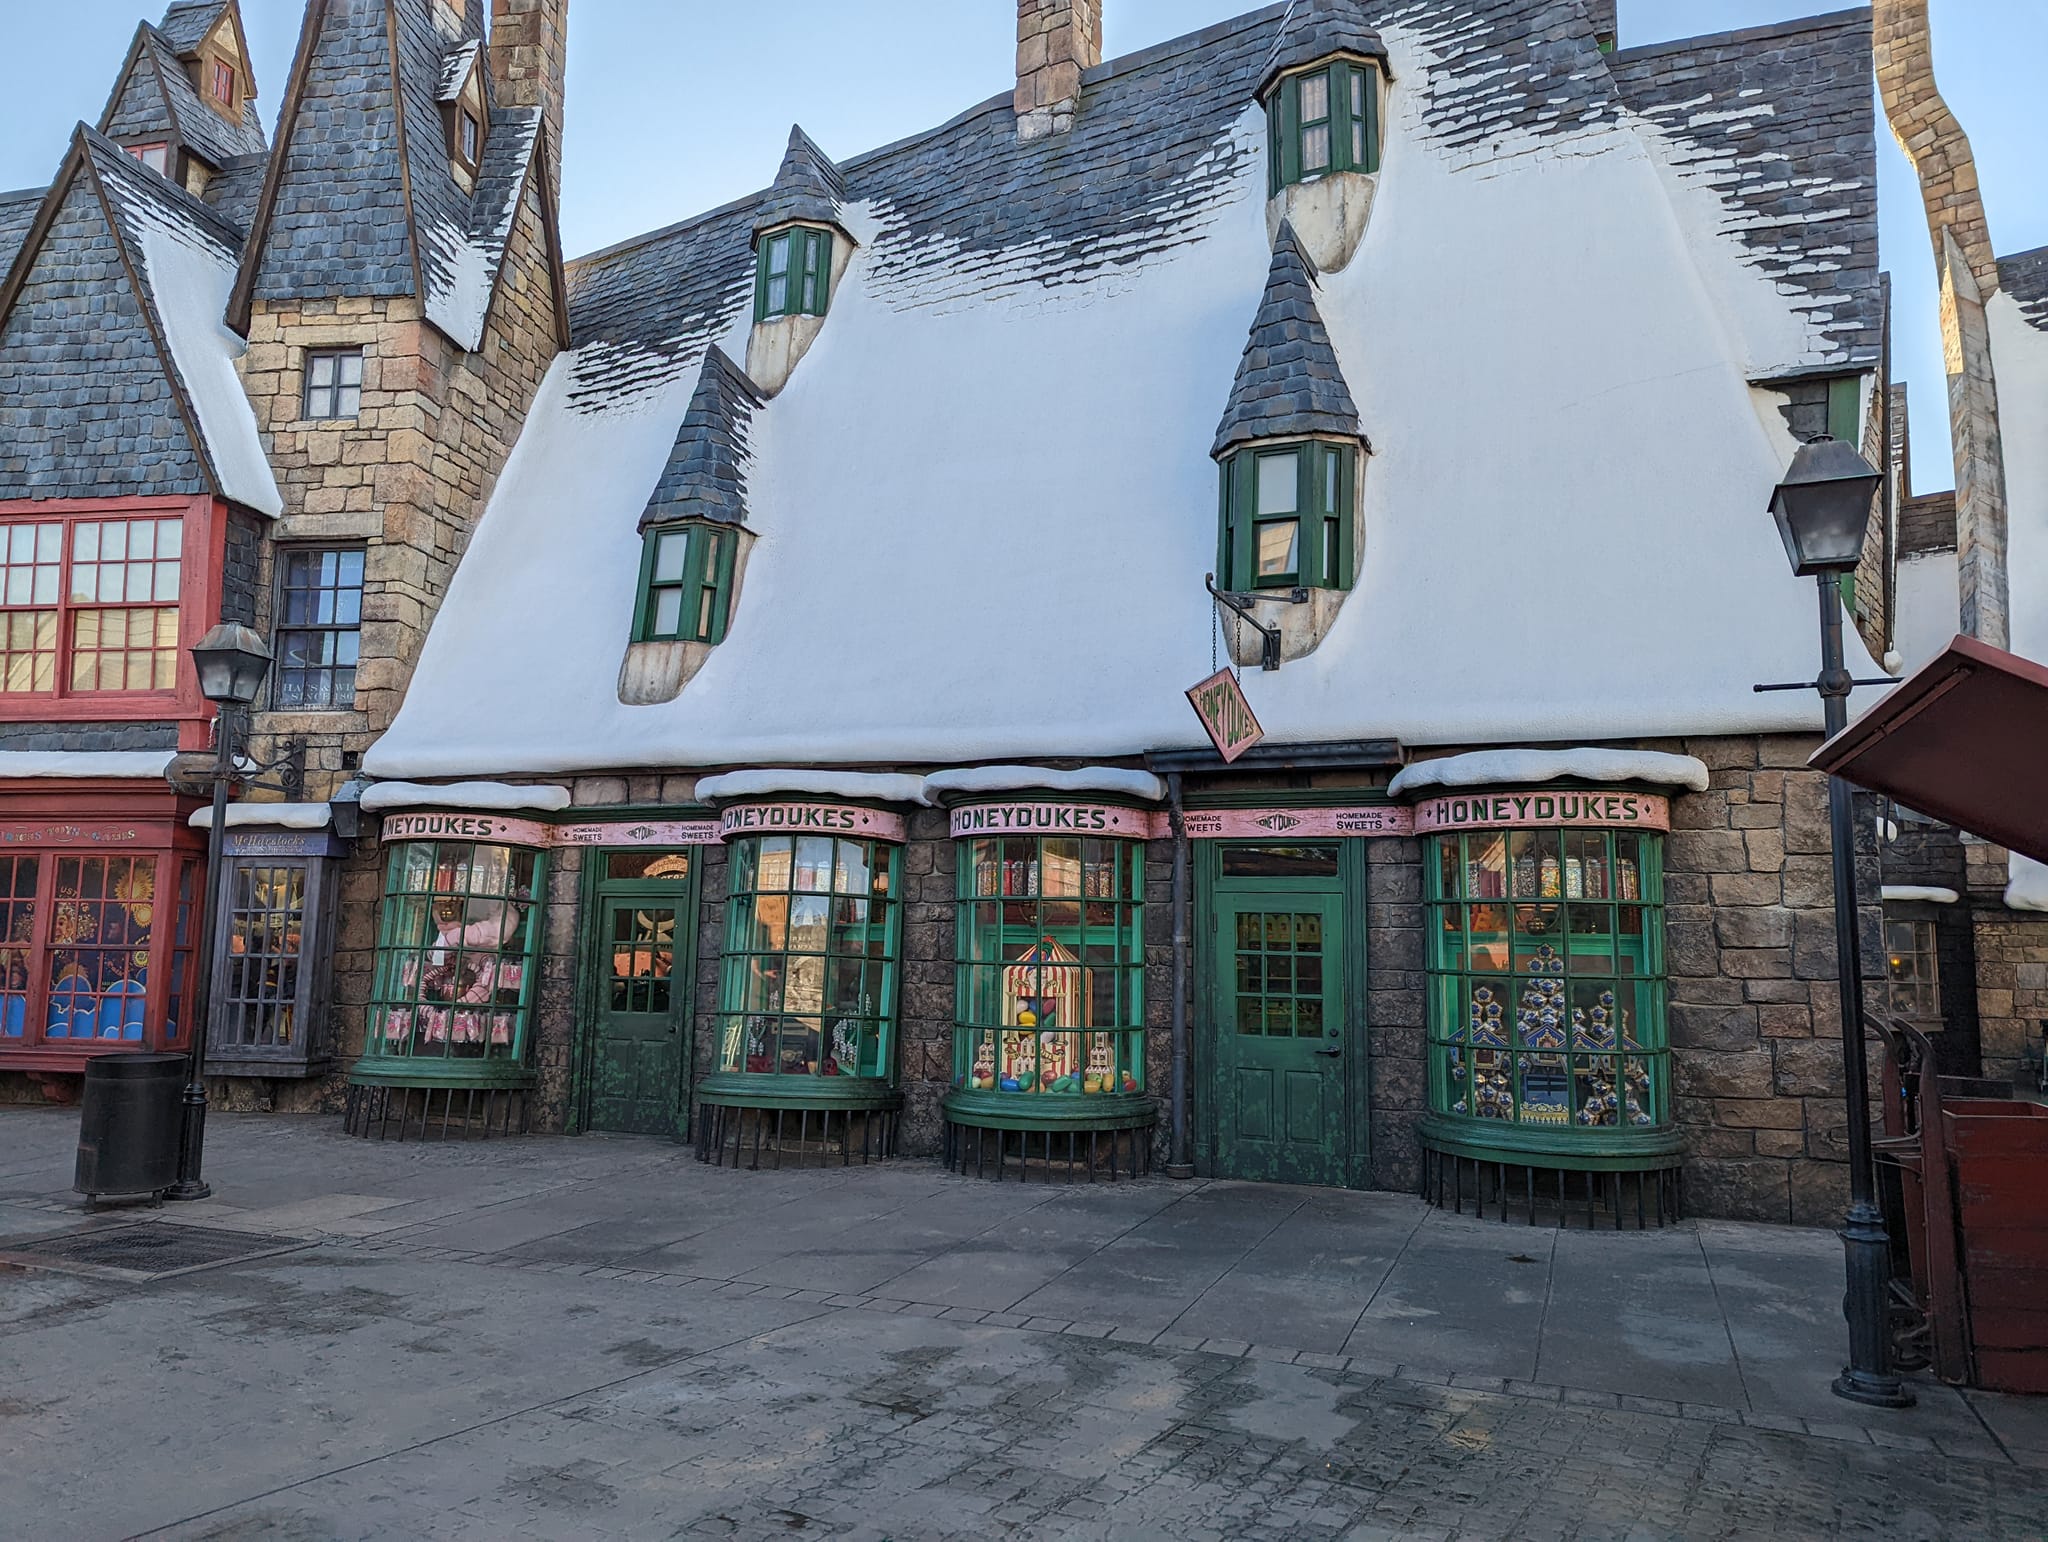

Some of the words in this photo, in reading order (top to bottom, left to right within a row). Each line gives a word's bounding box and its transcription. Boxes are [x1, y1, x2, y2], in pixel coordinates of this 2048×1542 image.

[1200, 681, 1255, 748] HONEYDUKES
[1437, 796, 1639, 824] HONEYDUKES
[953, 807, 1106, 831] HONEYDUKES
[1184, 823, 1222, 831] WEETS
[1336, 820, 1382, 830] SWEETS
[572, 833, 602, 841] SWEETS
[681, 831, 714, 839] SWEETS
